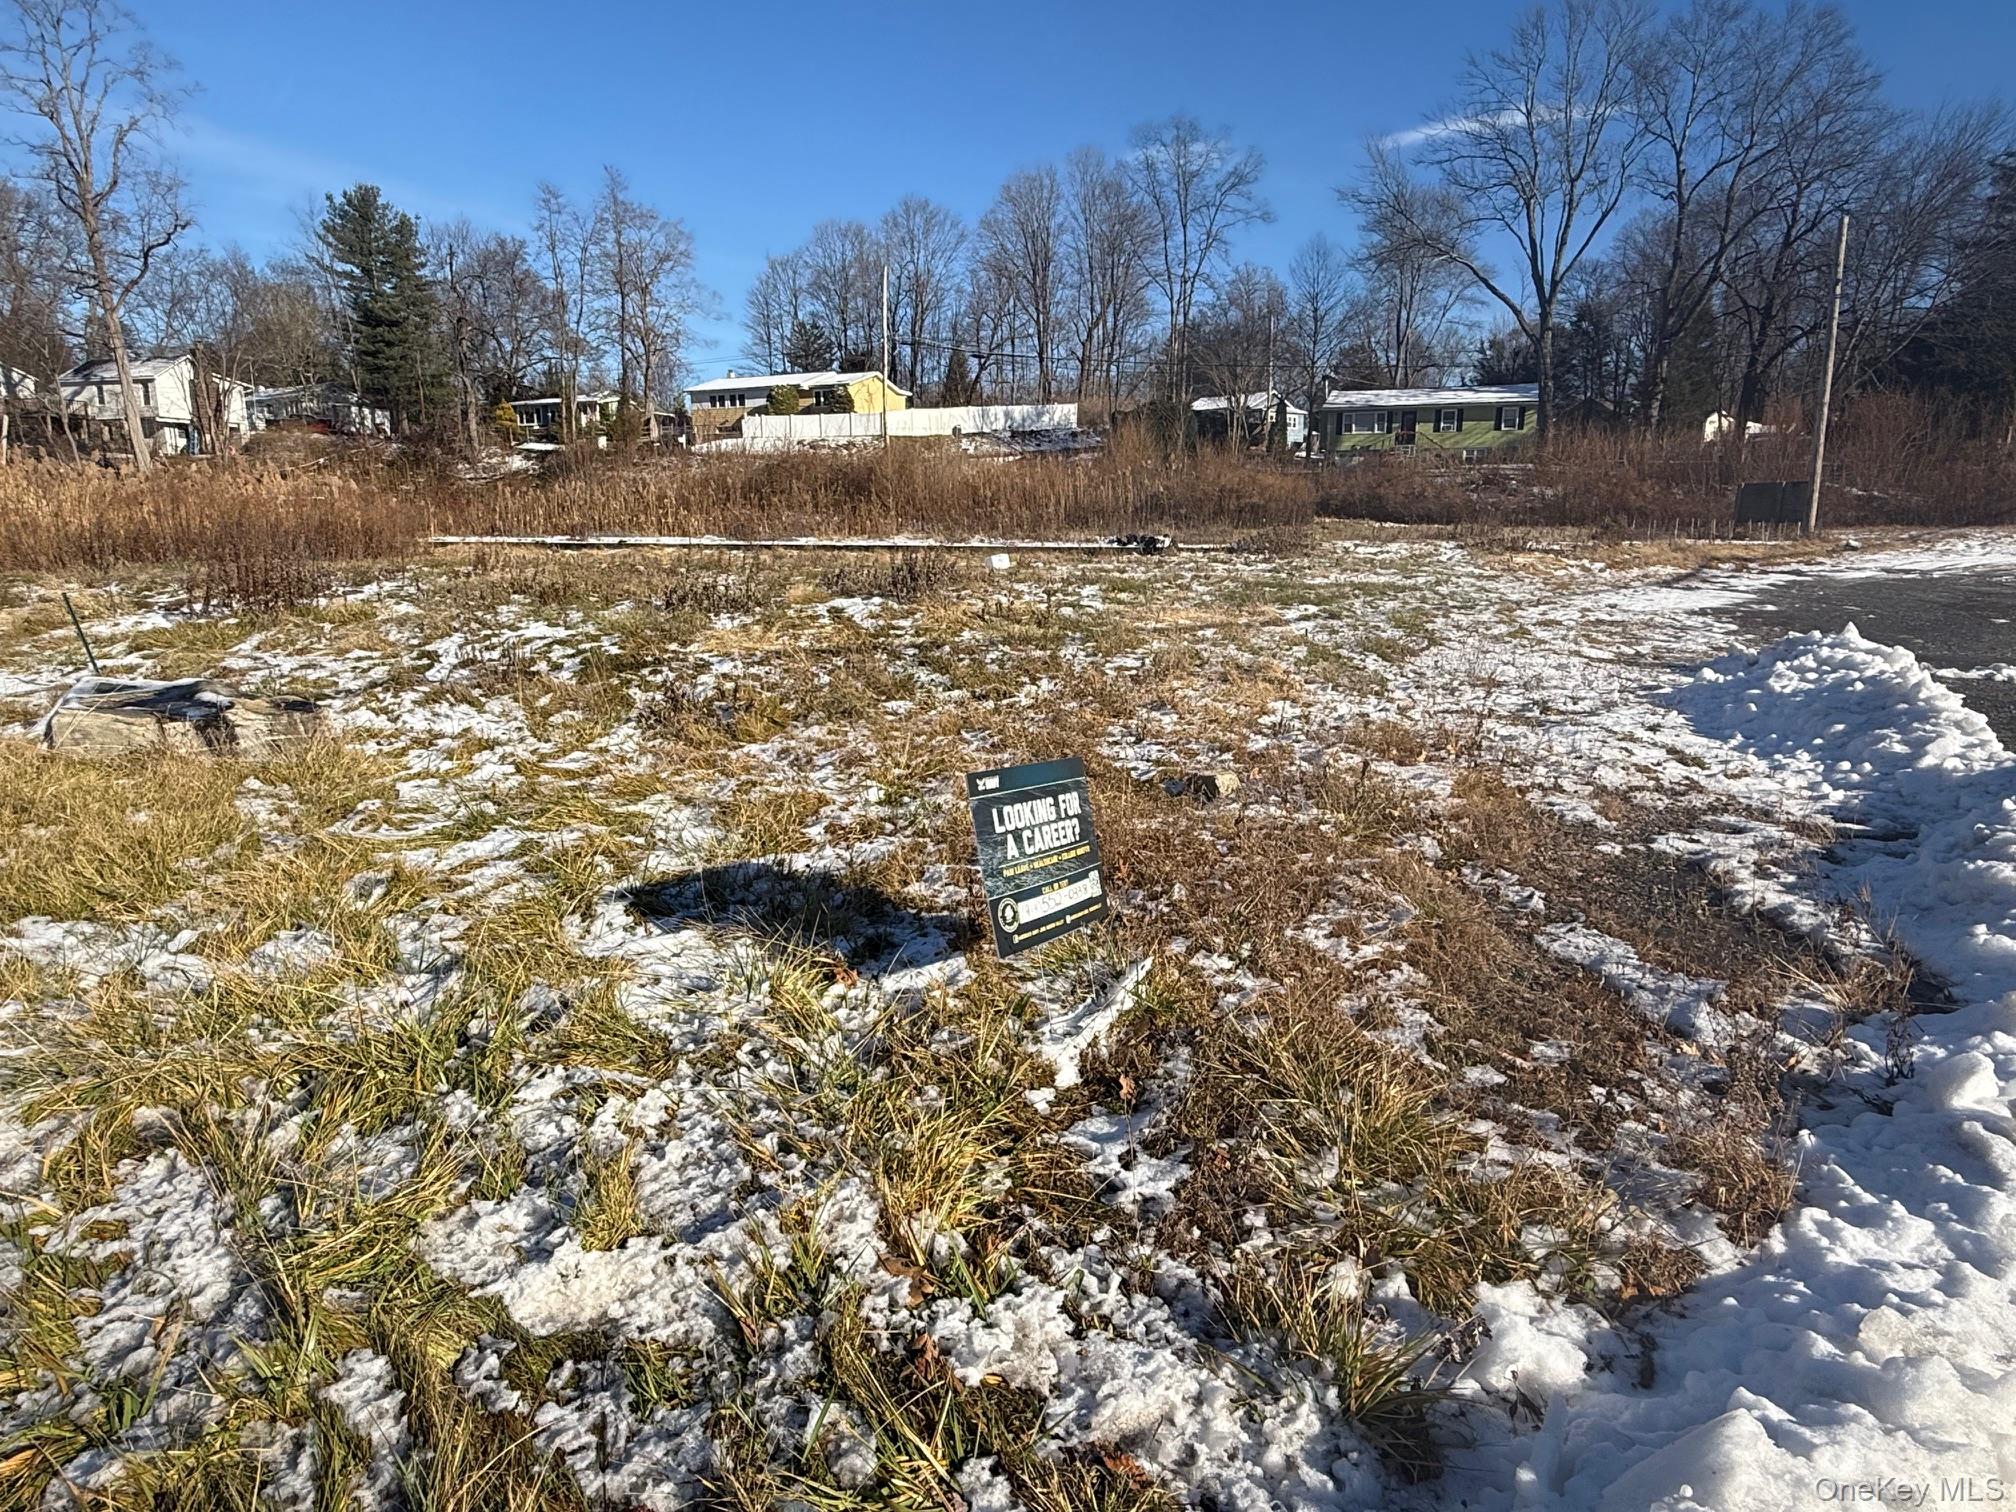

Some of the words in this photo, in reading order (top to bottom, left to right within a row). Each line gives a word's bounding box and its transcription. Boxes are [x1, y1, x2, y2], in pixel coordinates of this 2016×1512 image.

[992, 797, 1057, 834] LOOKING
[1058, 791, 1082, 818] FOR
[1006, 833, 1020, 860] A
[1022, 818, 1081, 855] CAREER?
